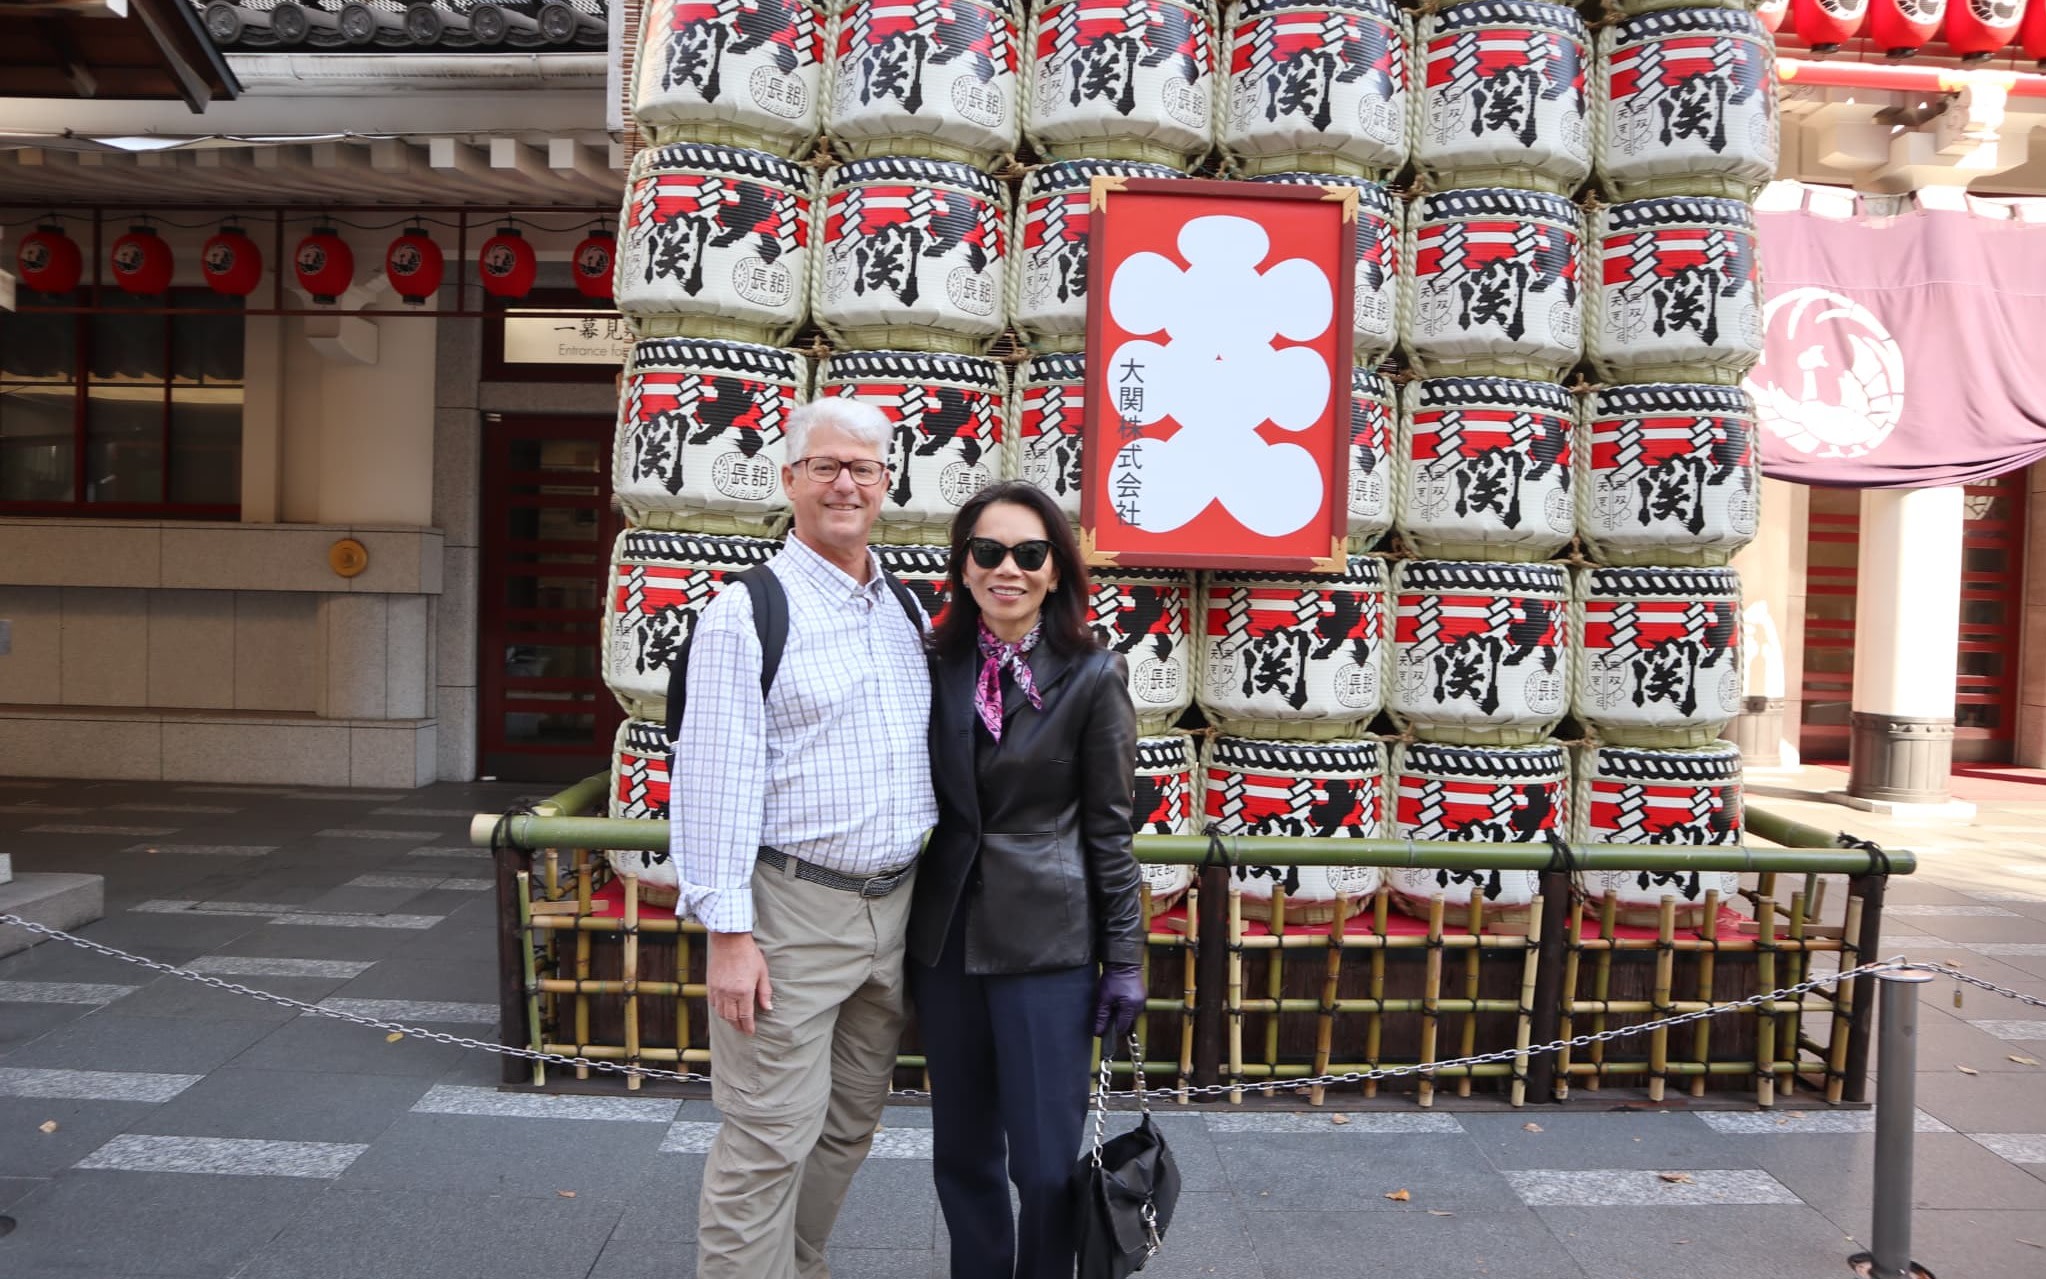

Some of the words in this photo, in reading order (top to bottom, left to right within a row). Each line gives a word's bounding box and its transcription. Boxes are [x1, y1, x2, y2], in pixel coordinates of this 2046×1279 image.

[559, 343, 608, 357] Entrance
[1115, 357, 1145, 527] 大関株式会社
